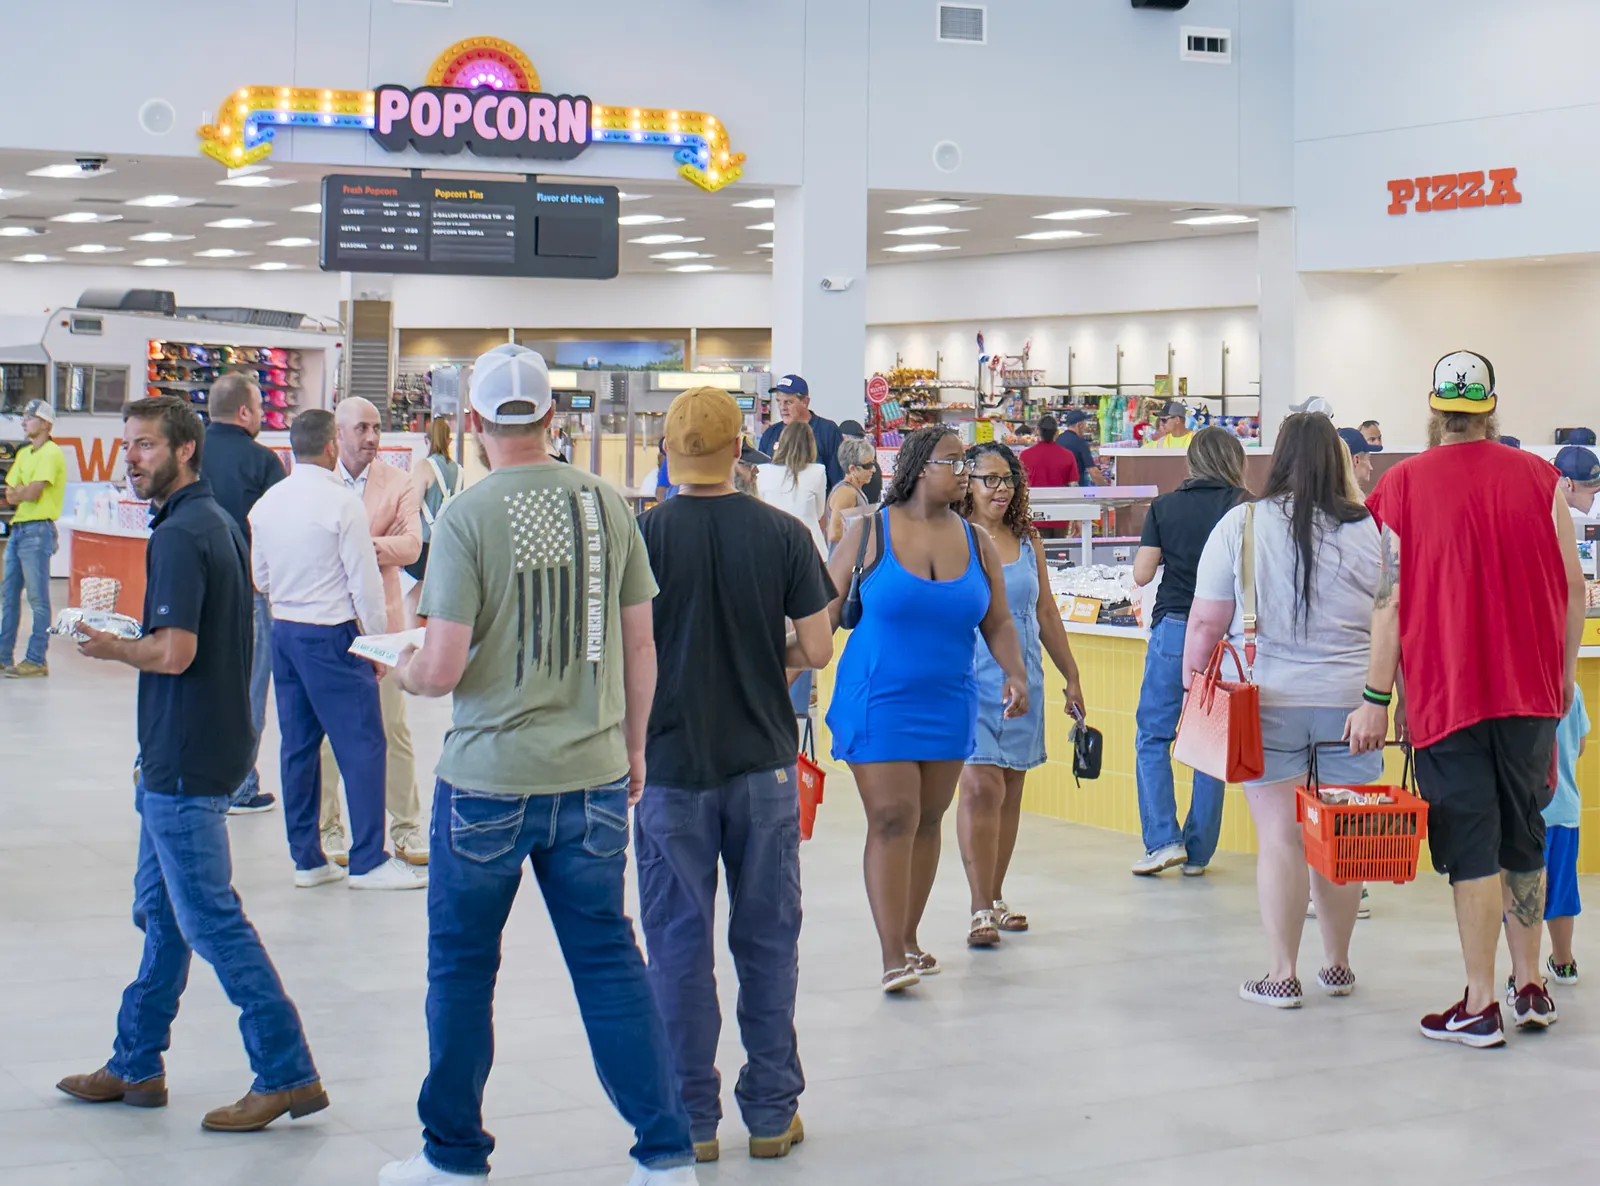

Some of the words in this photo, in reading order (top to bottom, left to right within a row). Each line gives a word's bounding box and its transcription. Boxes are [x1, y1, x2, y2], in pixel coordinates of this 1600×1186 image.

[379, 89, 587, 144] POPCORN
[343, 185, 363, 194] Fresh
[365, 186, 398, 196] Popcorn
[434, 188, 467, 200] Popcorn
[469, 190, 484, 200] Tins
[537, 192, 559, 203] Flavor
[560, 194, 569, 203] of
[570, 194, 583, 204] the
[584, 195, 604, 205] Week
[1387, 167, 1522, 215] PIZZA
[343, 208, 366, 216] CLASSIC
[459, 213, 491, 221] COLLECTIBLE
[492, 213, 501, 221] TIN
[580, 491, 599, 530] PROUD
[588, 534, 601, 550] TO
[588, 555, 601, 572] BE
[588, 577, 601, 593] AN
[586, 598, 602, 661] AMERICAN
